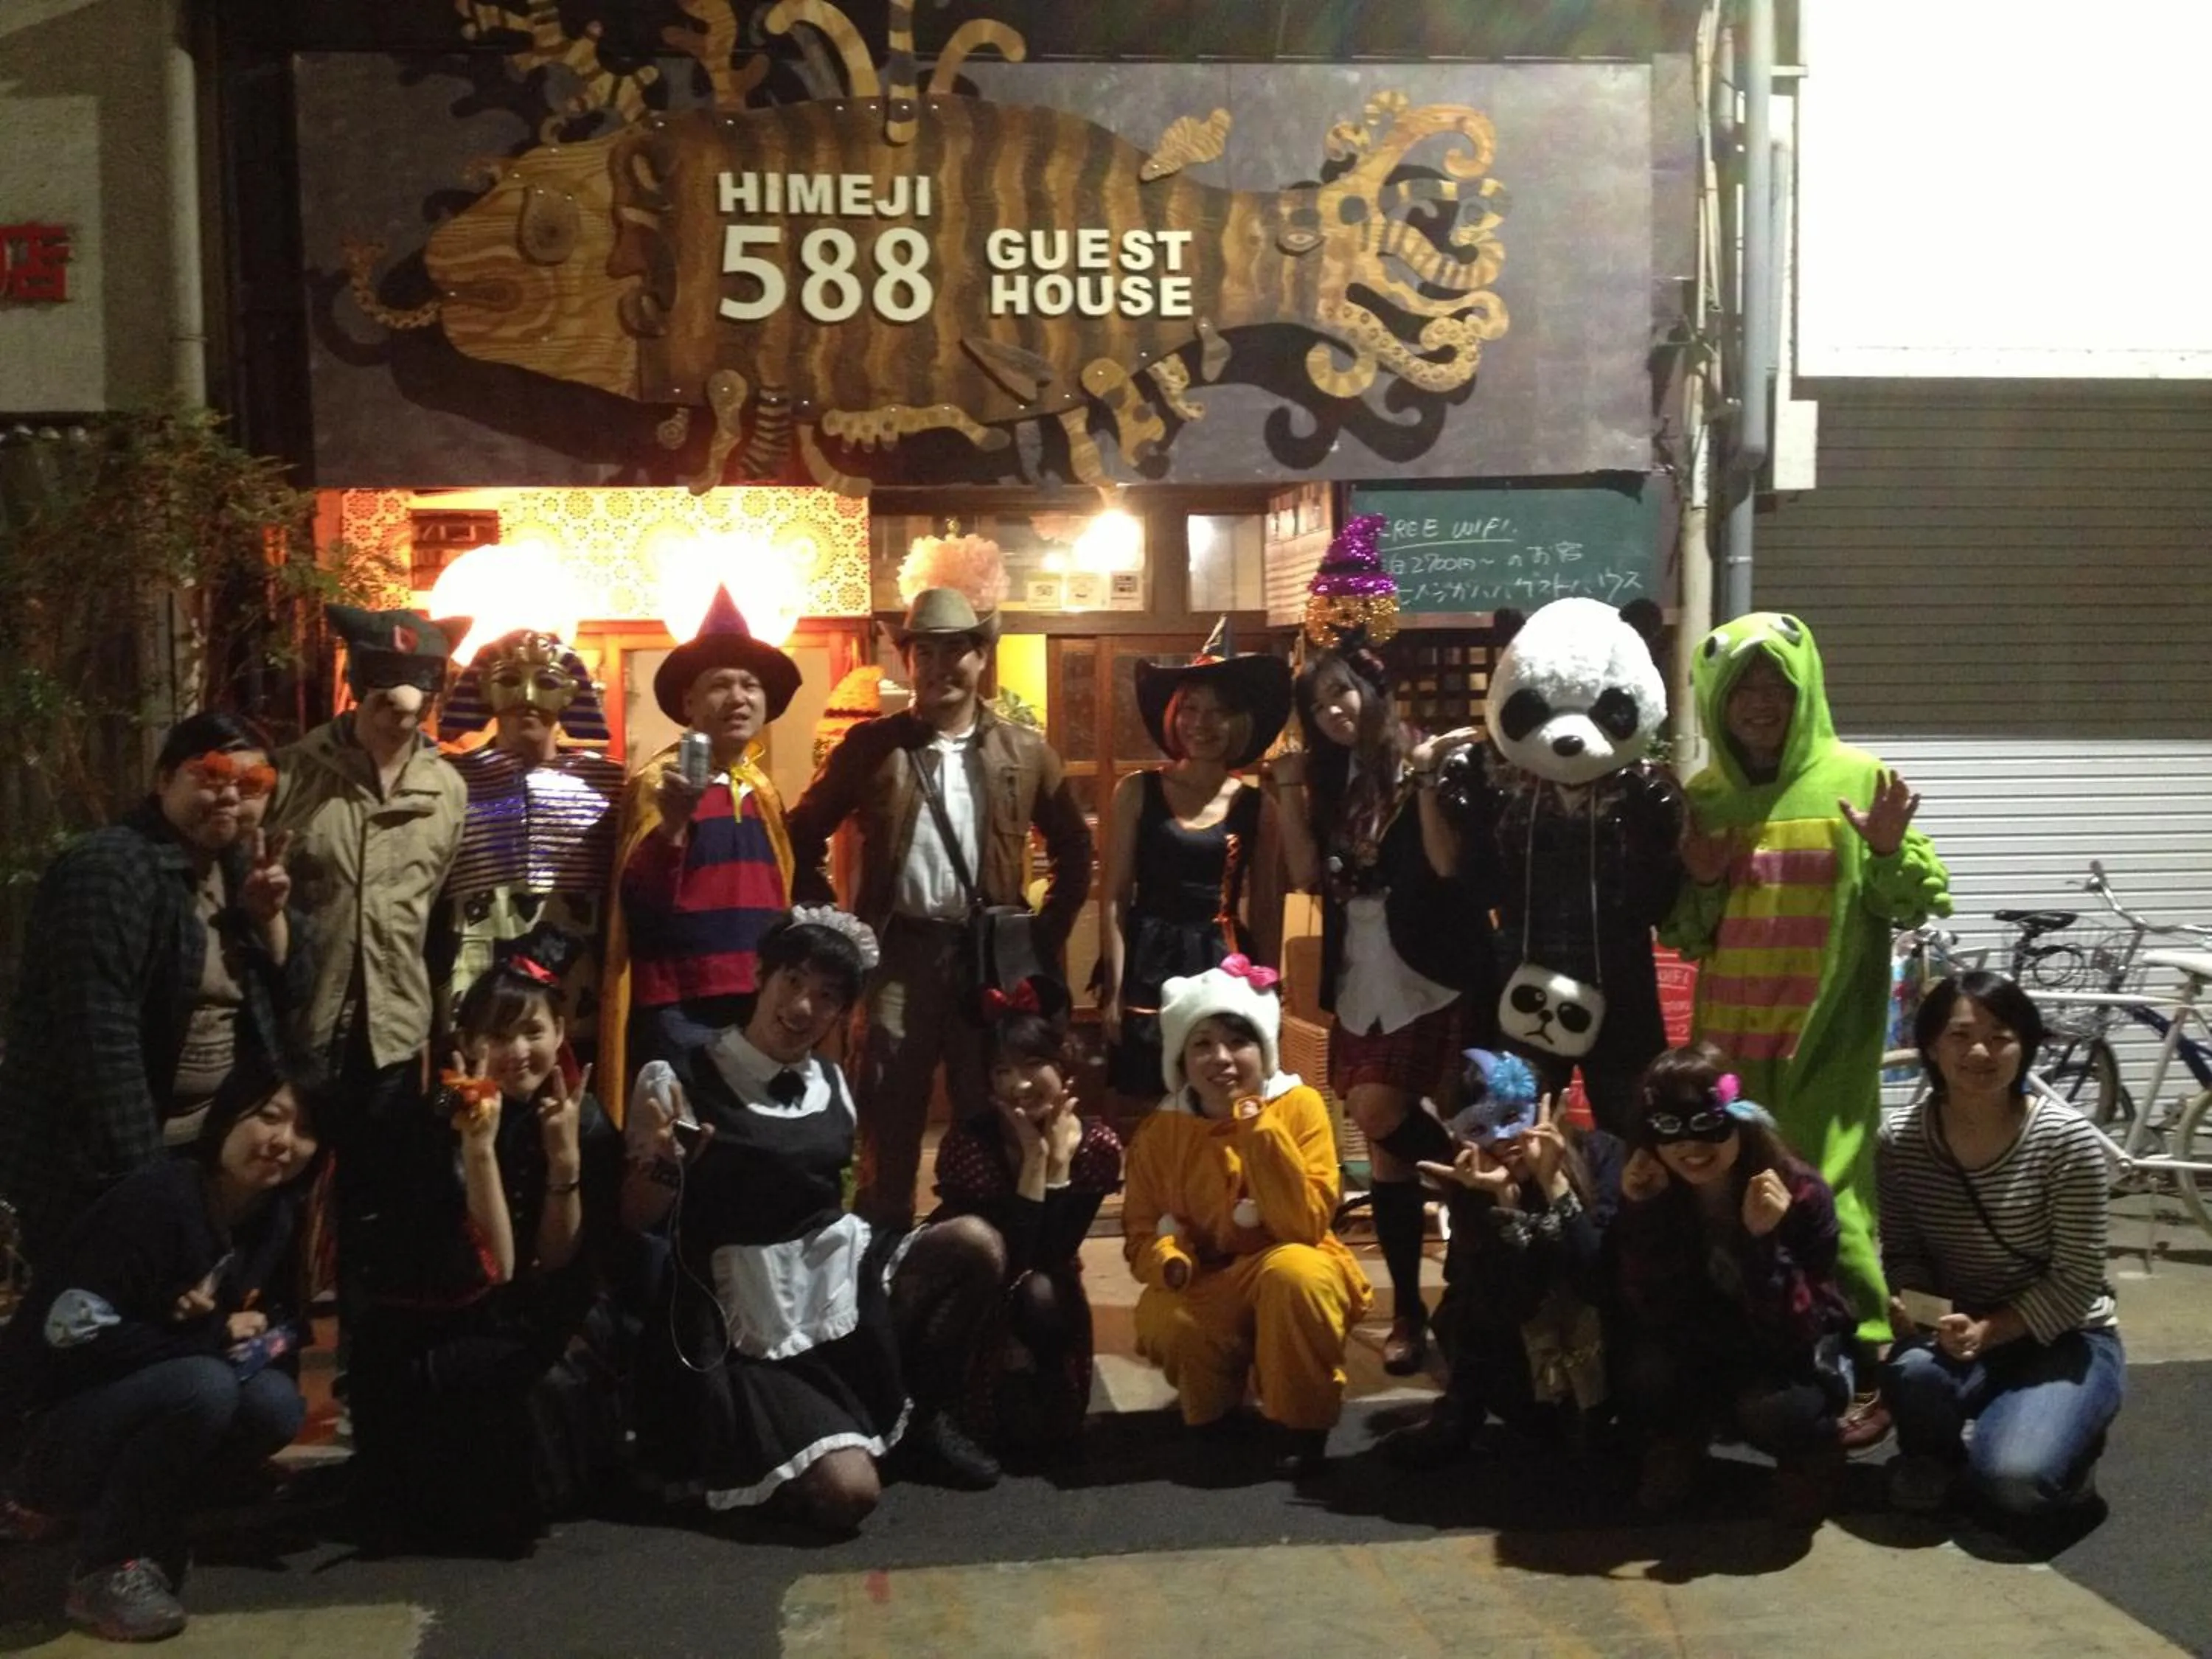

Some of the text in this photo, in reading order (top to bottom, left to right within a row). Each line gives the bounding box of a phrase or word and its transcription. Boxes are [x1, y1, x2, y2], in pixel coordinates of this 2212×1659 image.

[719, 172, 931, 217] HIMEJI
[0, 223, 67, 302] 店
[987, 229, 1192, 271] GUEST
[720, 225, 933, 322] 588
[991, 274, 1192, 316] HOUSE
